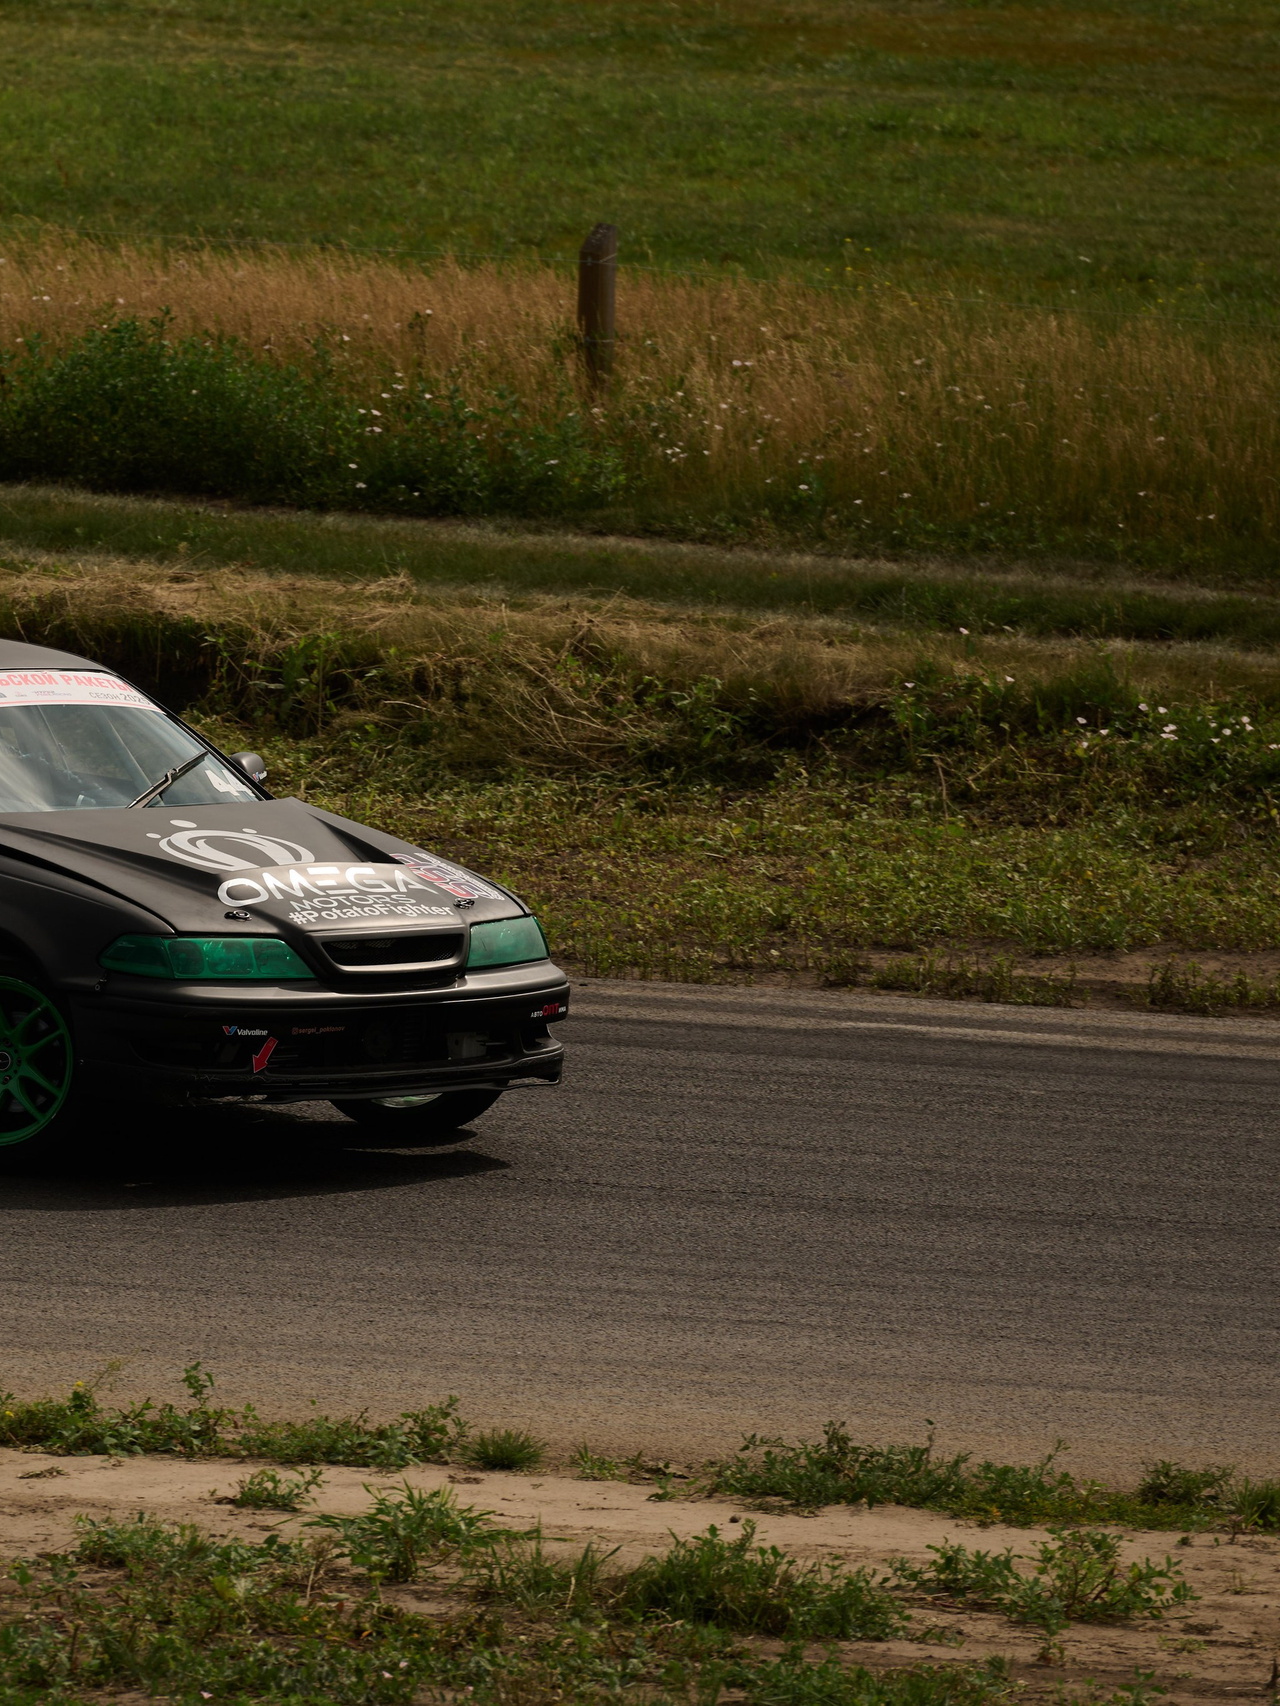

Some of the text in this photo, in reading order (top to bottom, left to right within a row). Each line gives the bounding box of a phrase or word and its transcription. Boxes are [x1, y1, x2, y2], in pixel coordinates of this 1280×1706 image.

[59, 674, 133, 693] РАКЕТЫ
[217, 866, 438, 908] OMEGA
[288, 902, 454, 925] #PotatoFighter
[289, 894, 417, 913] MOTORS
